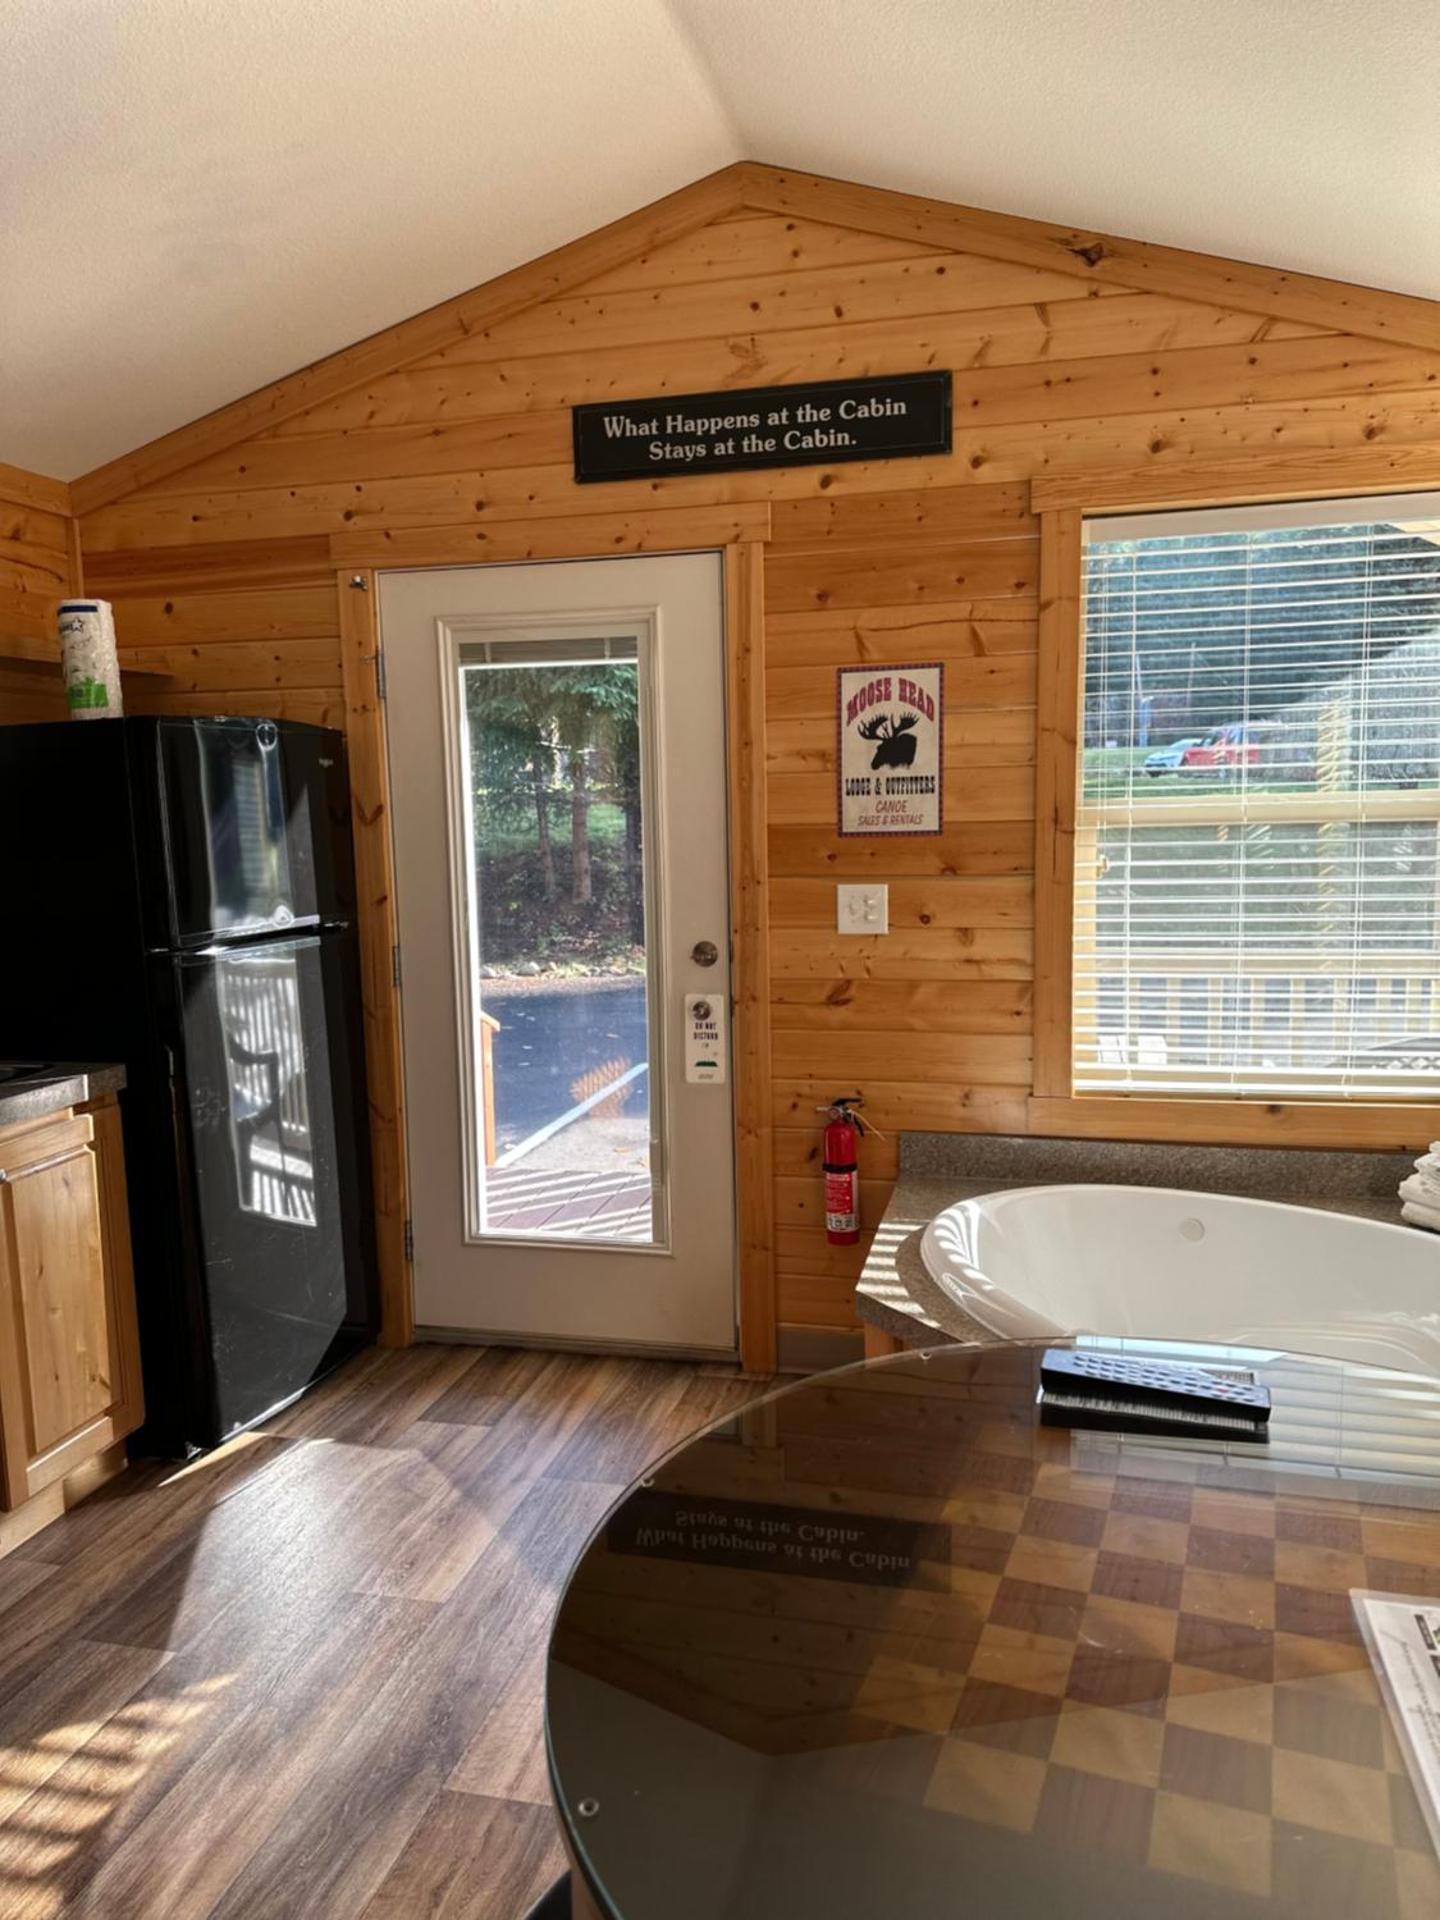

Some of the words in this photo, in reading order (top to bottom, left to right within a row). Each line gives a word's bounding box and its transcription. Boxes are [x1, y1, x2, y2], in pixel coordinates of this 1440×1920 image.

[603, 416, 659, 439] What
[665, 411, 760, 437] Happens
[767, 409, 790, 426] at
[797, 403, 832, 424] the
[838, 399, 907, 420] Cabin
[649, 441, 707, 462] Stays
[714, 436, 735, 456] at
[742, 434, 776, 453] the
[783, 429, 857, 450] Cabin.
[846, 677, 892, 727] MOOSE
[898, 677, 935, 723] HEAD
[845, 778, 871, 796] LODGE
[874, 777, 882, 796] &
[885, 775, 936, 796] OUTFITTERS
[875, 800, 908, 813] CANOE
[857, 815, 880, 827] SALES
[890, 814, 924, 825] RENTALS
